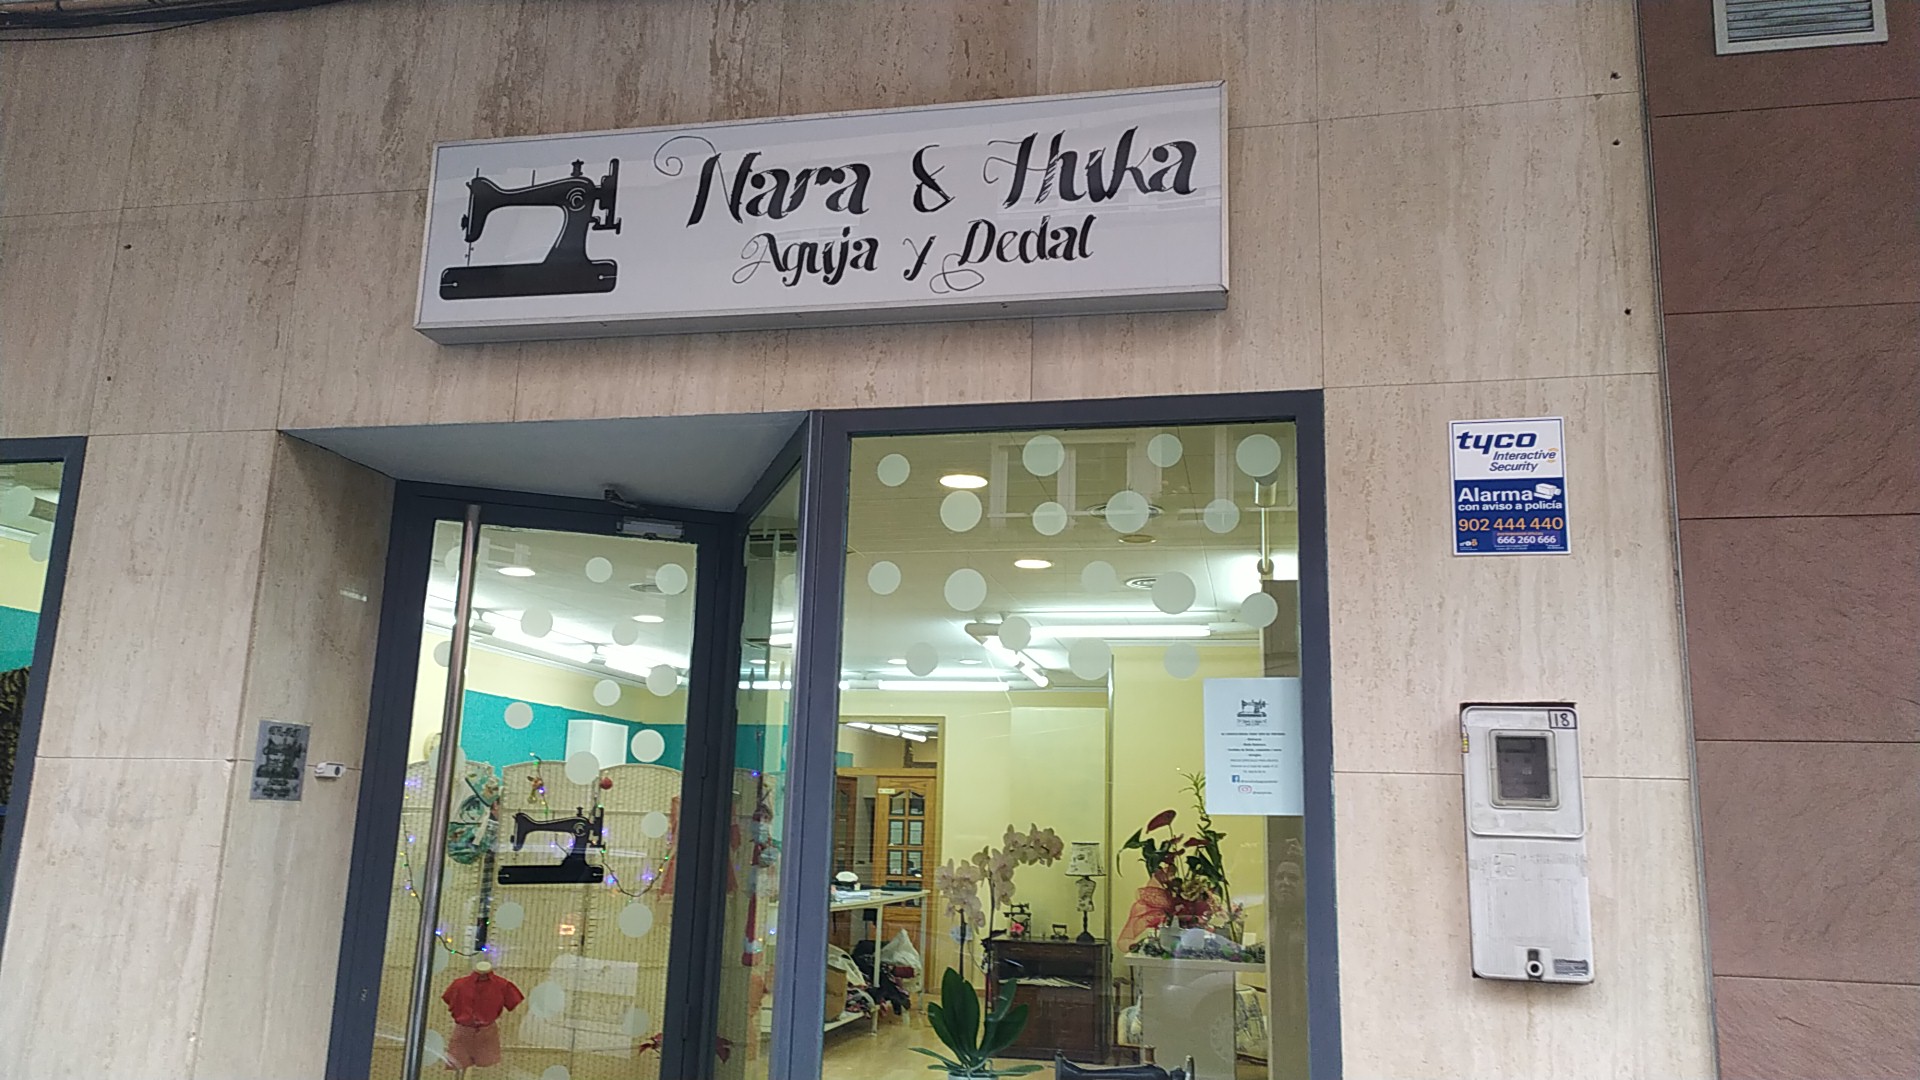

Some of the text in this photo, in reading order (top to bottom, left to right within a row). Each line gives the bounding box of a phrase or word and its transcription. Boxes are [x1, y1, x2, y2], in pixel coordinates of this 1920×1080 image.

[654, 135, 872, 228] Nara
[912, 144, 956, 213] &
[732, 214, 1098, 294] Aguja y Dedal
[1456, 431, 1538, 455] tyco
[1492, 449, 1557, 461] Interactive
[1489, 460, 1539, 473] Security
[1458, 487, 1533, 503] Alarma
[1458, 500, 1563, 512] con aviso a policía
[1458, 516, 1564, 532] 902 444 440
[1497, 535, 1557, 545] 666 260 666
[1554, 712, 1570, 727] 18
